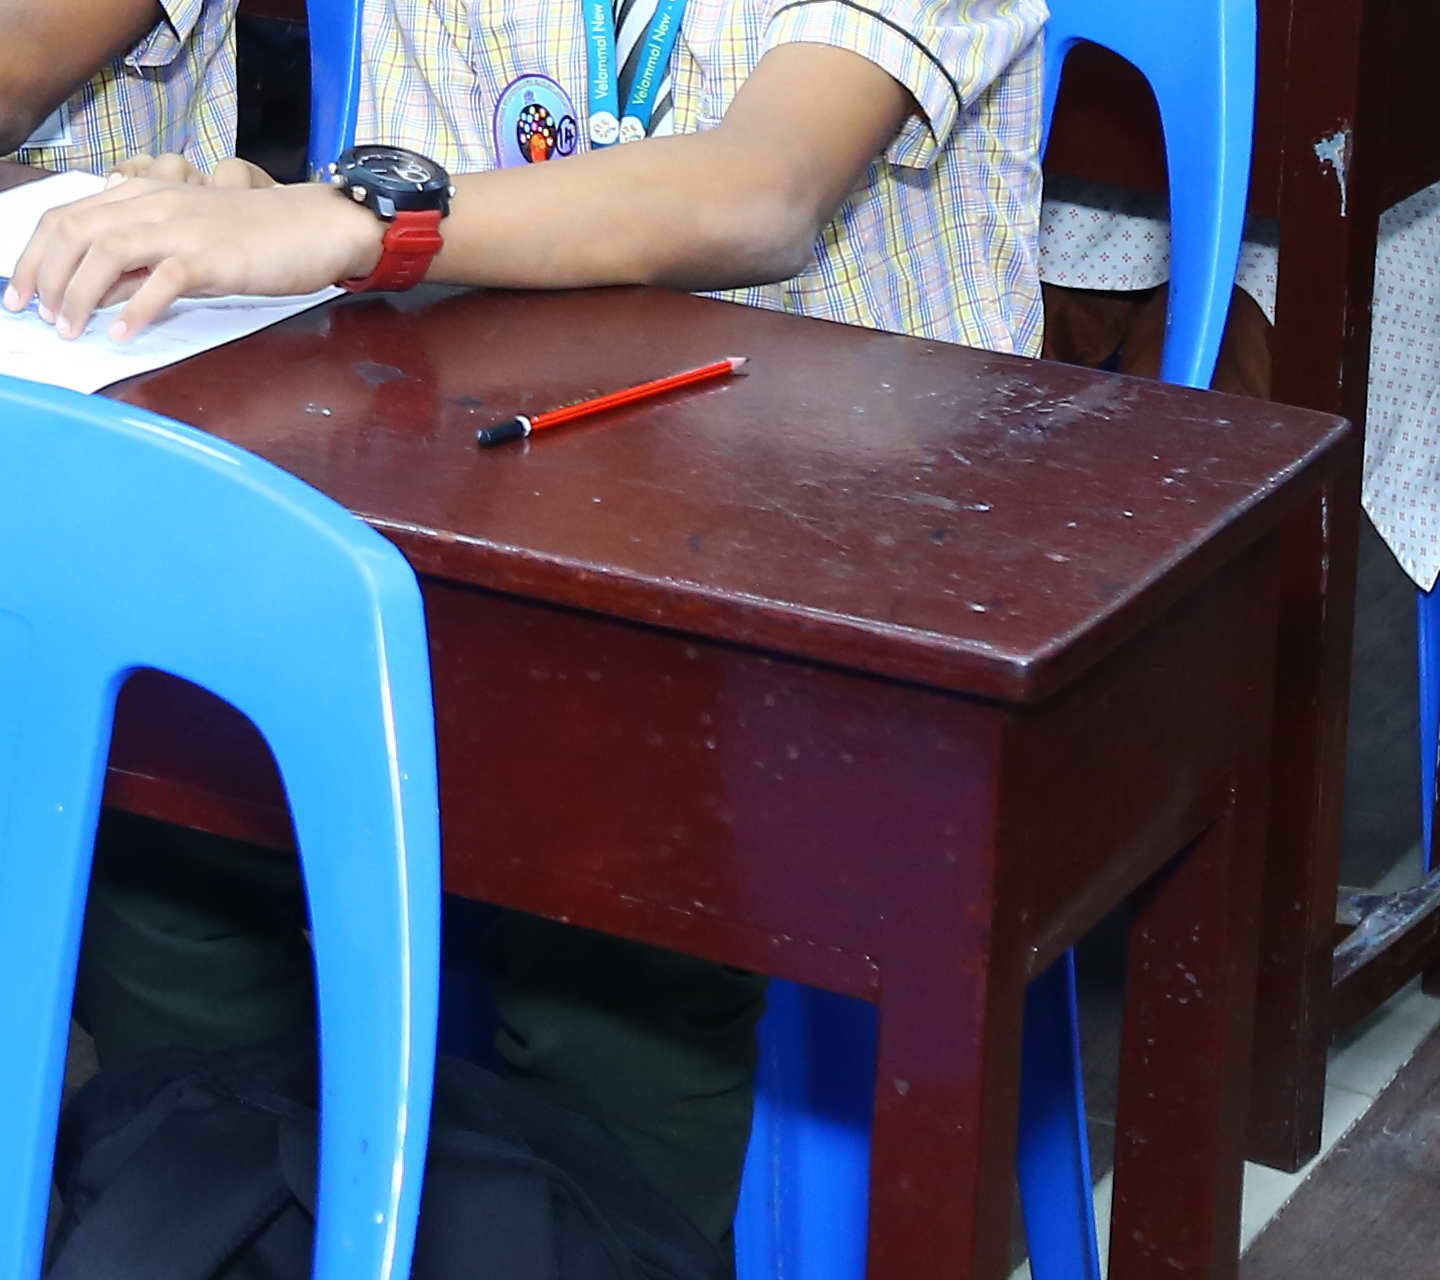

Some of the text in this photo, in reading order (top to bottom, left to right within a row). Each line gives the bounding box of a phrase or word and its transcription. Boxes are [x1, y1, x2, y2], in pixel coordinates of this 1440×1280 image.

[592, 2, 605, 32] New
[595, 33, 609, 100] Velammal
[632, 43, 663, 106] Velammal
[652, 14, 671, 42] New
